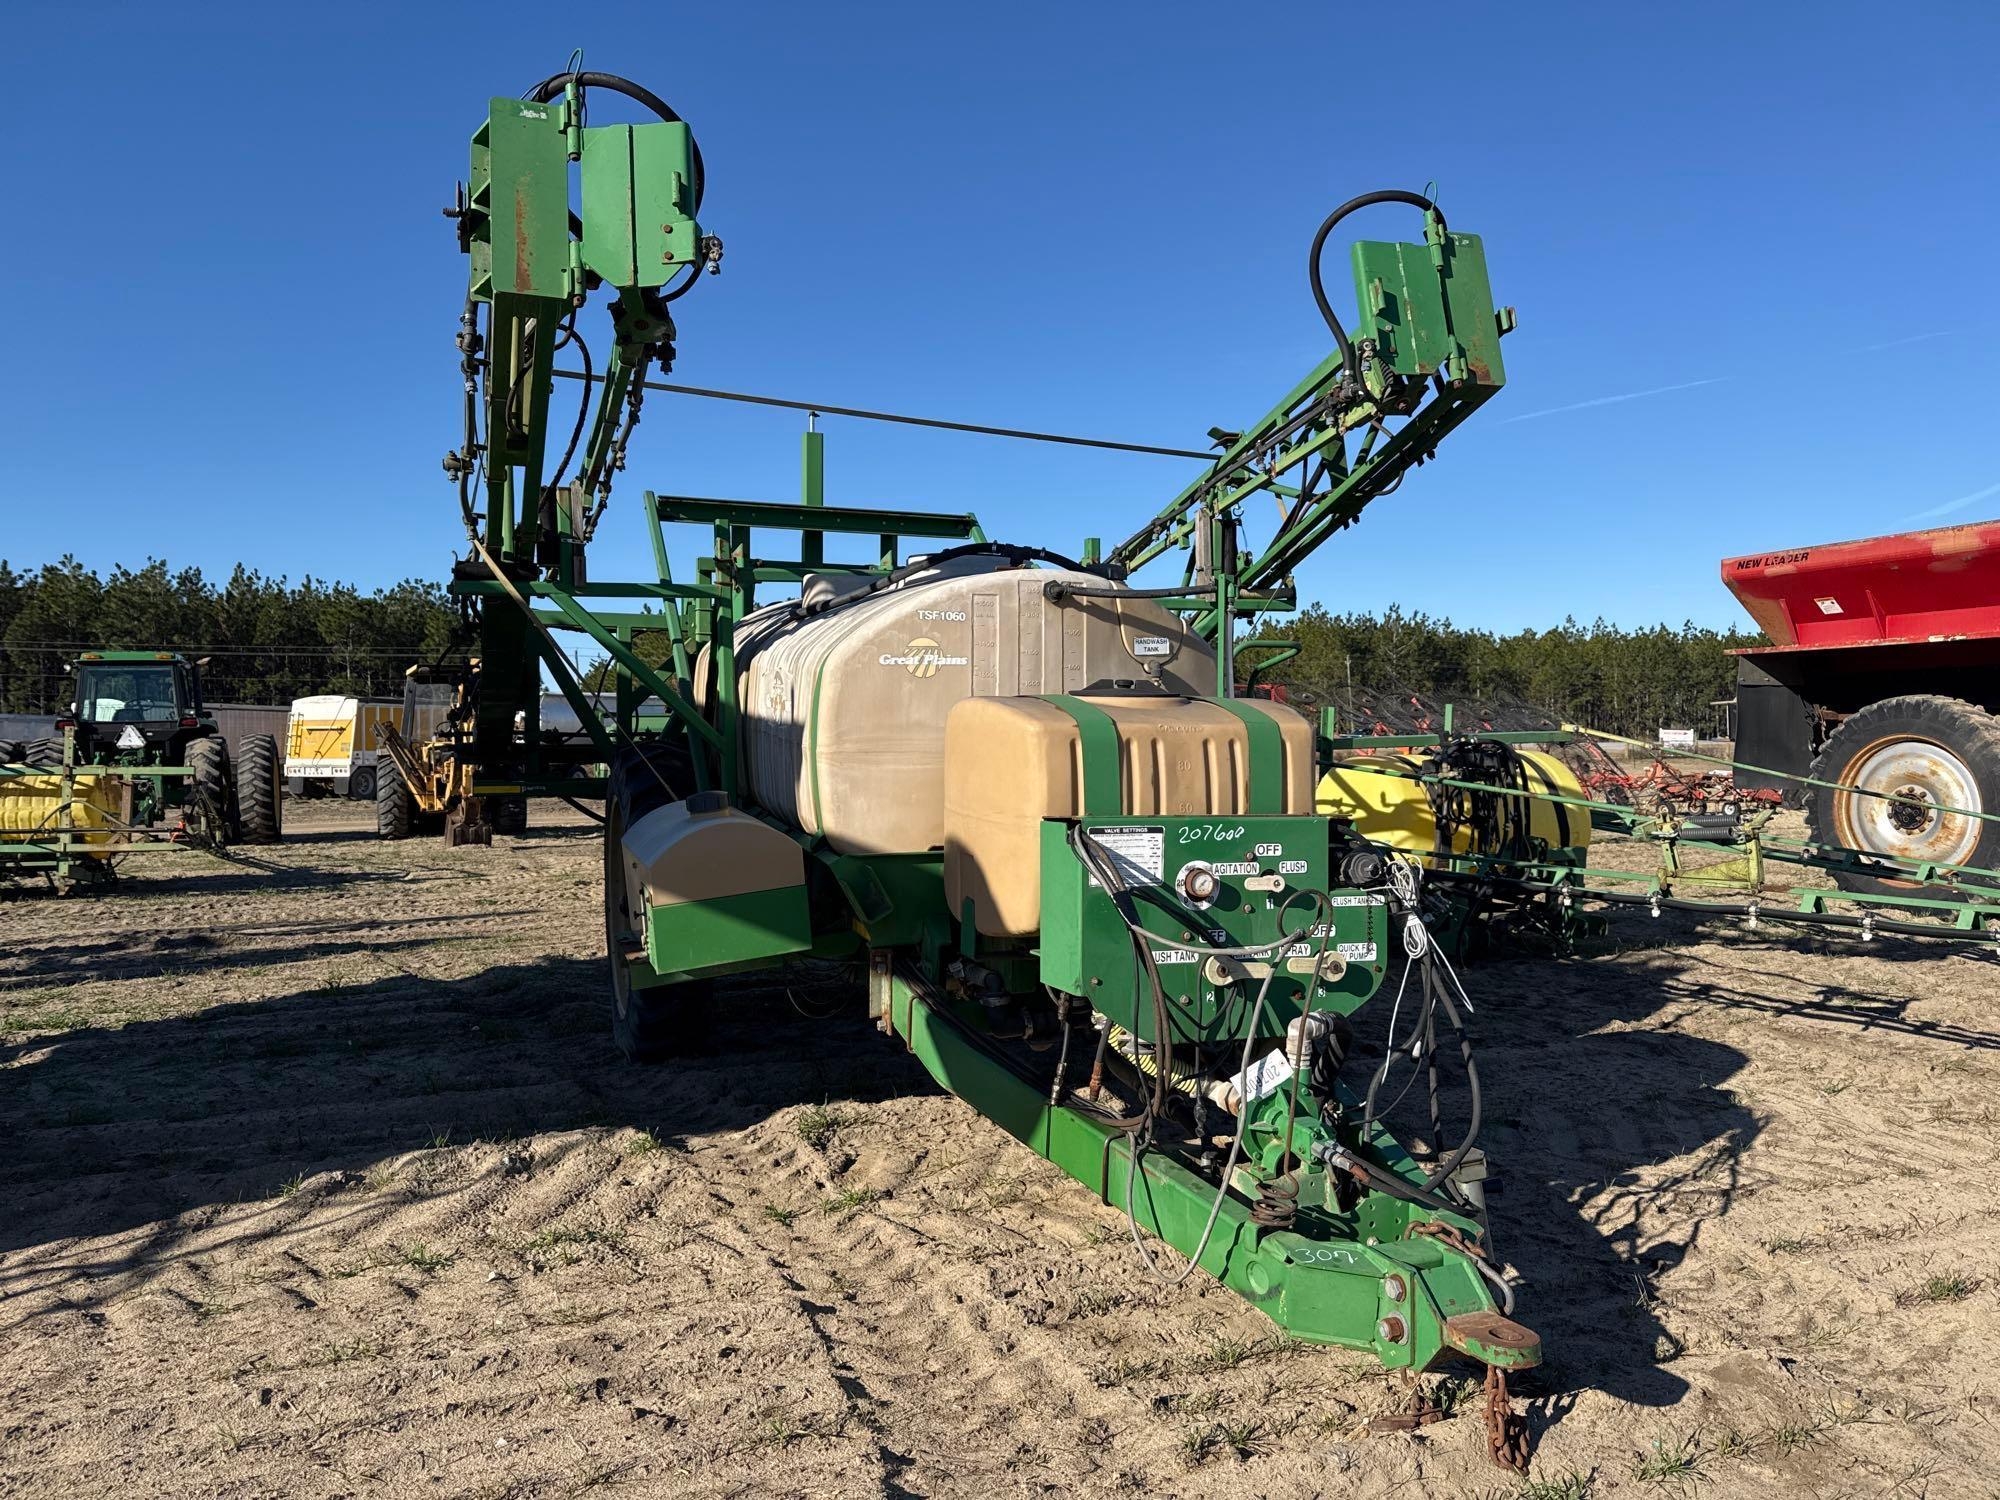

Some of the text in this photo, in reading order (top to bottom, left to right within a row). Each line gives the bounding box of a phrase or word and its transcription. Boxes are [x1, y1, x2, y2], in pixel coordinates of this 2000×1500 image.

[1737, 559, 1762, 570] NEW
[917, 610, 966, 621] TSF1060
[879, 654, 968, 665] Great Plains
[1257, 845, 1279, 855] OFF
[1214, 864, 1257, 875] AGITATION
[1281, 862, 1306, 872] FLUSH
[1333, 897, 1352, 906] FLUSH
[1174, 951, 1196, 961] TANK
[1207, 992, 1213, 1001] 2
